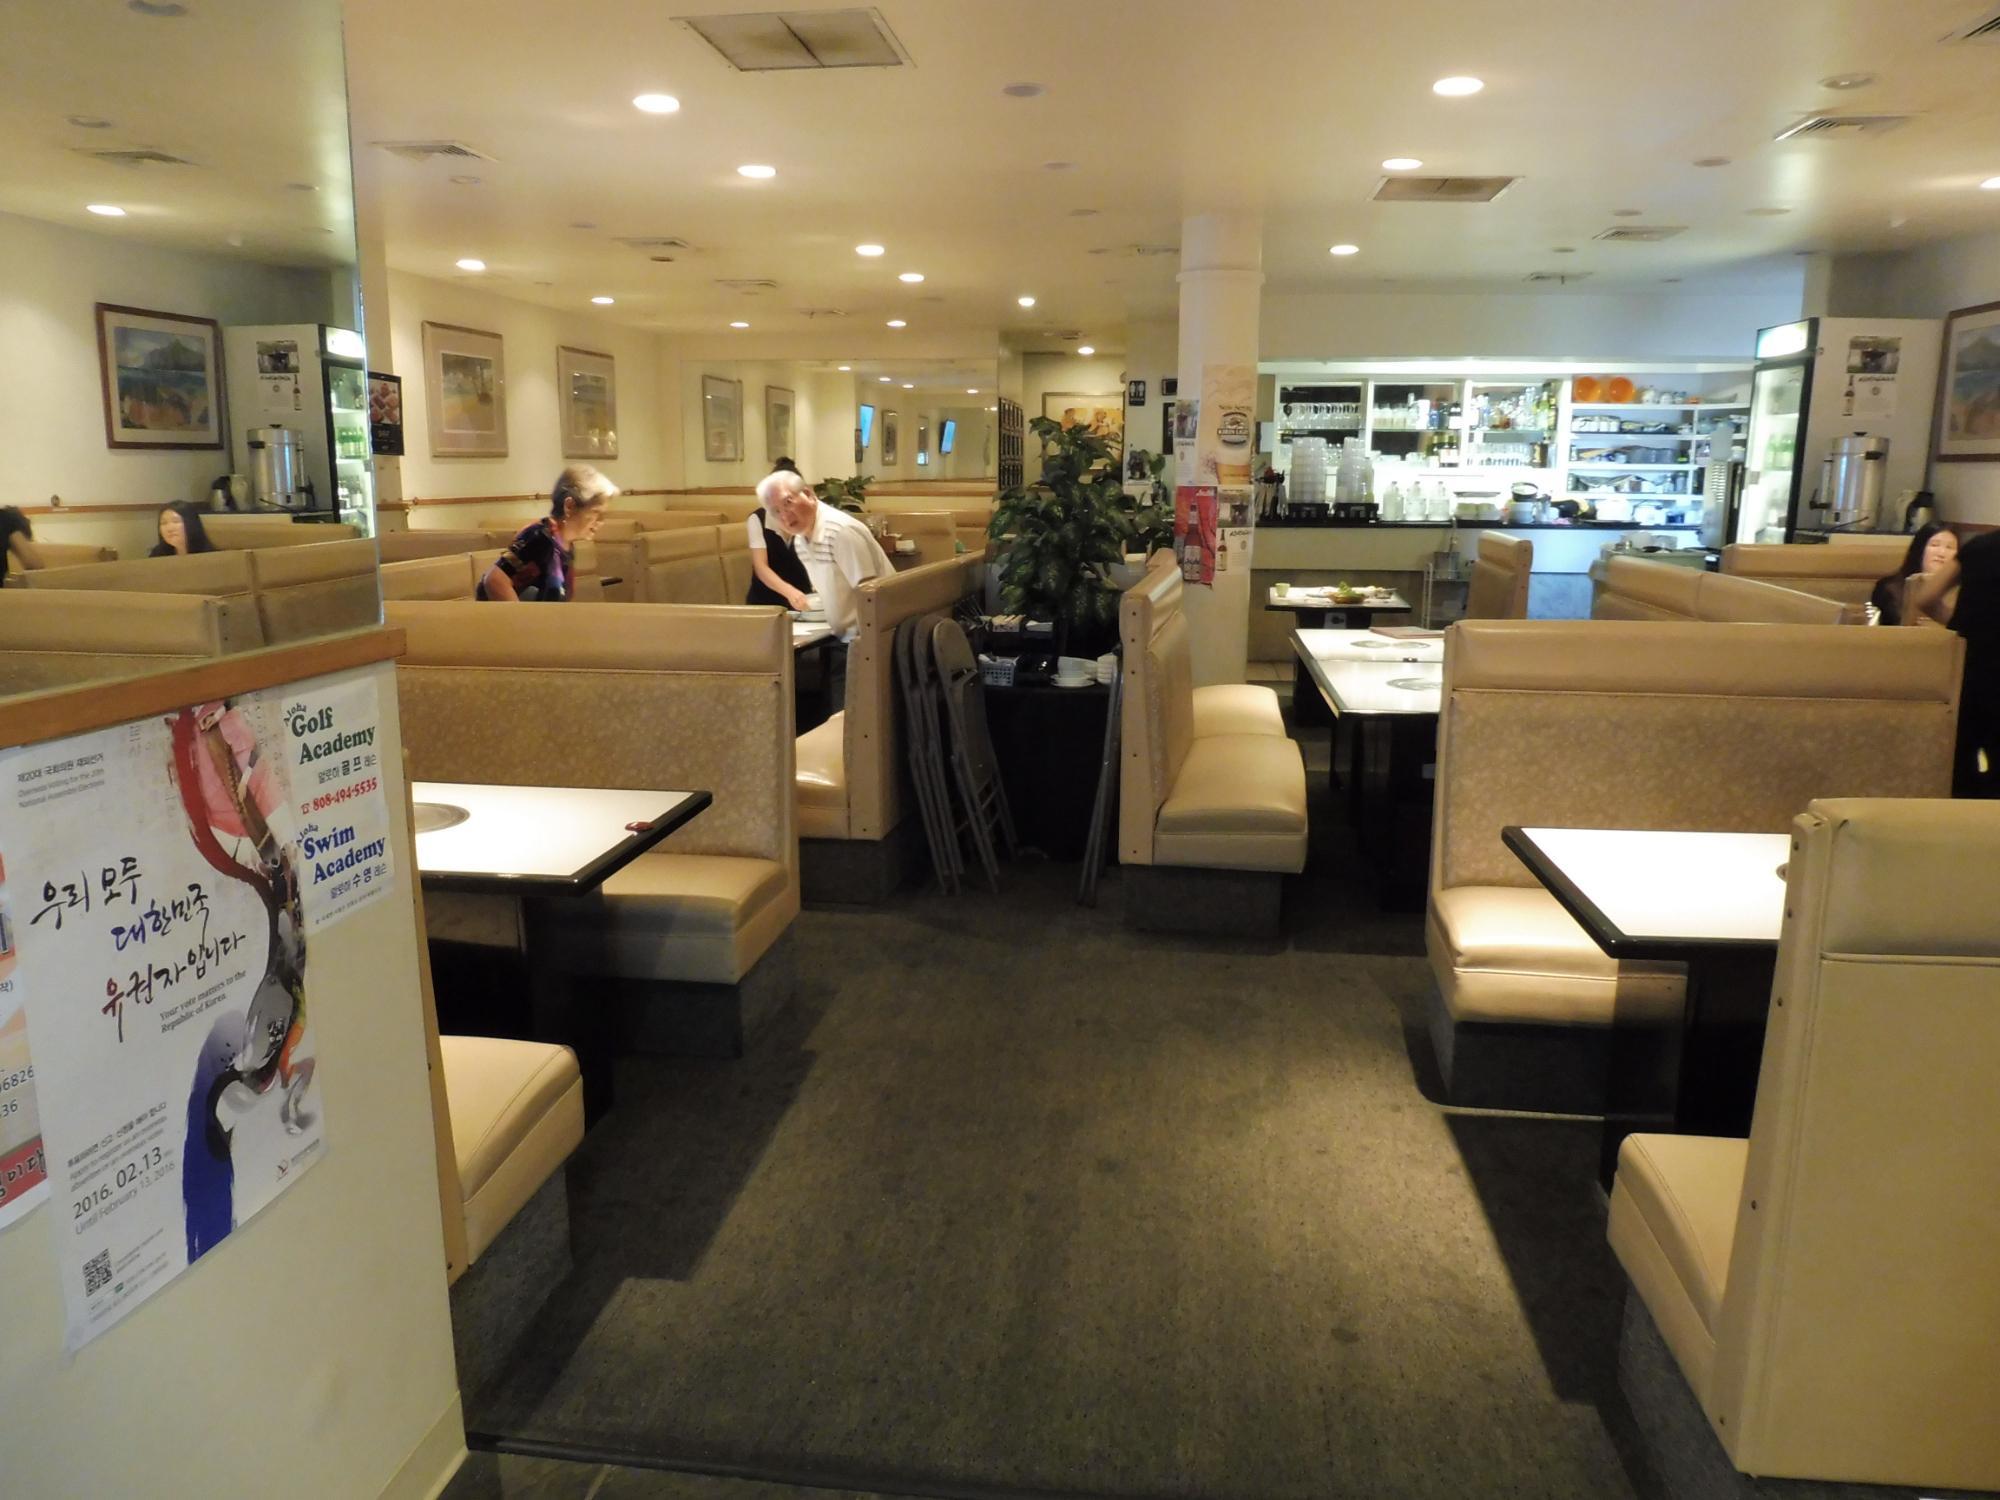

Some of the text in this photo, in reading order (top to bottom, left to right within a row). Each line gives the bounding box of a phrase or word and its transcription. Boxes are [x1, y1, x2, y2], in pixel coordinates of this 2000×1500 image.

[291, 706, 333, 738] Golf
[299, 726, 375, 765] Academy
[303, 825, 355, 860] Swim
[313, 837, 386, 885] Academy
[30, 857, 142, 930] 우리 모두
[72, 1183, 113, 1220] 2016.
[116, 1146, 162, 1188] 02.13
